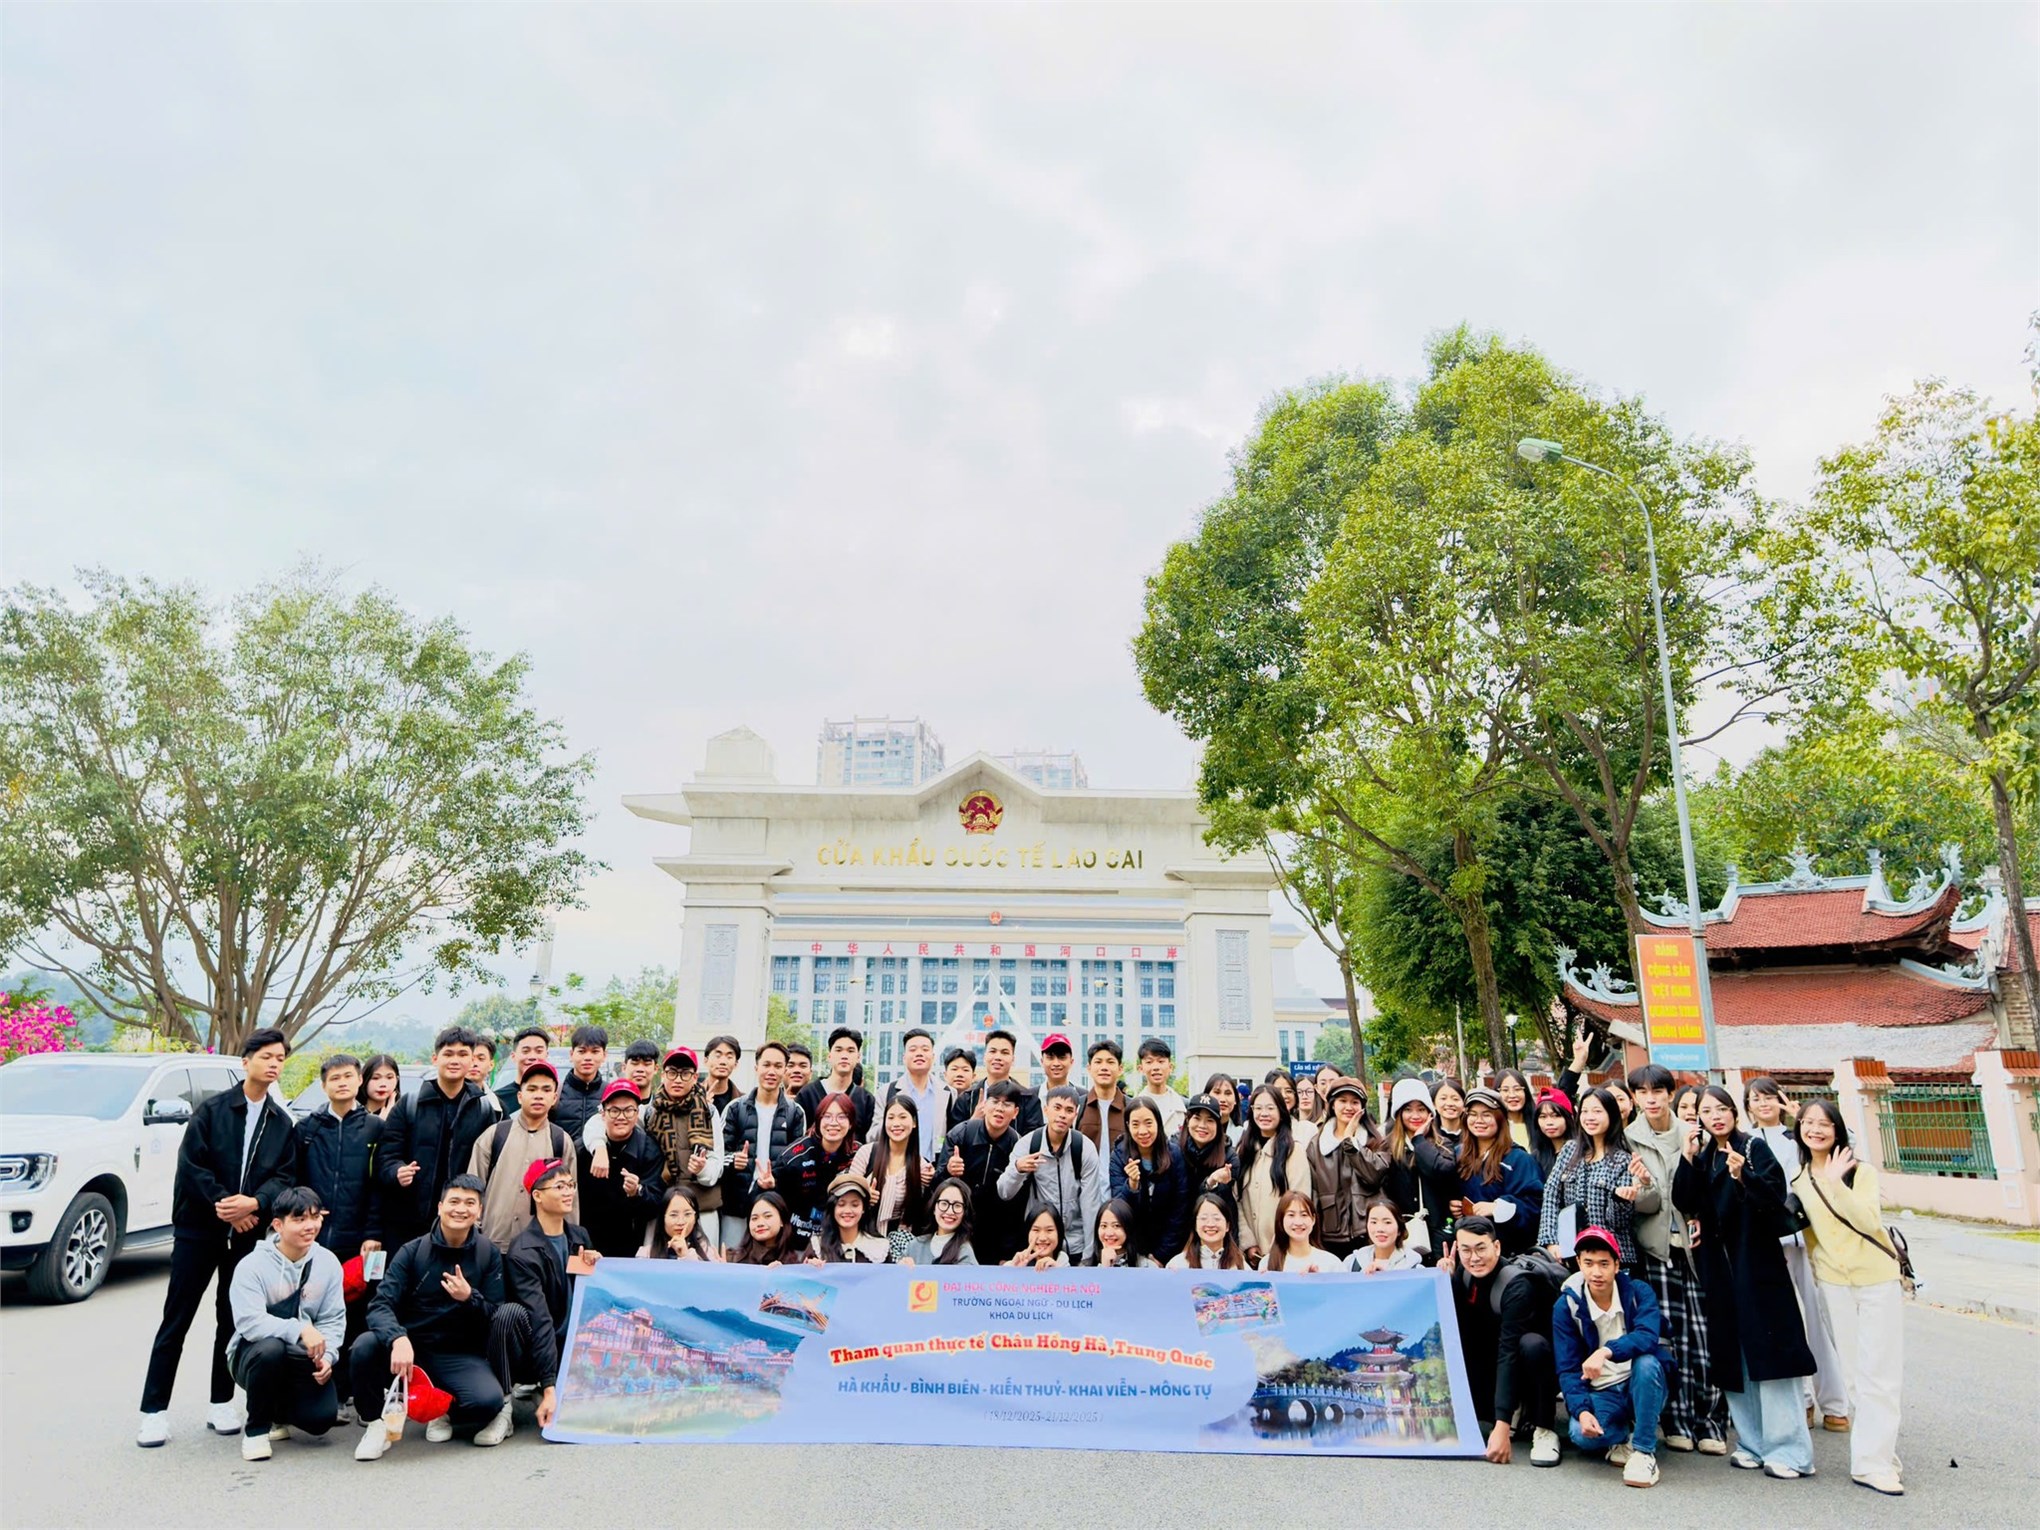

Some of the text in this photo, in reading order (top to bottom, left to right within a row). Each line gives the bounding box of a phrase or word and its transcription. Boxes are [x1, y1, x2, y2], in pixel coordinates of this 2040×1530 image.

[1105, 848, 1142, 869] CAI
[811, 941, 1177, 959] 中华人民共和国河口口岸
[953, 1297, 992, 1307] TRƯỜNG
[995, 1298, 1025, 1308] NGOẠI
[1056, 1300, 1069, 1308] DU
[990, 1311, 1015, 1320] KHOA
[1017, 1312, 1030, 1320] DU
[830, 1346, 880, 1364] Tham
[882, 1342, 925, 1358] quan
[929, 1338, 966, 1353] thực
[969, 1332, 987, 1349] tế
[991, 1334, 1033, 1348] Châu
[1170, 1349, 1213, 1368] Quốc
[838, 1377, 857, 1393] HÀ
[861, 1373, 900, 1393] KHẨU
[911, 1378, 945, 1394] BÌNH
[948, 1379, 980, 1395] BIÊN
[990, 1377, 1022, 1396] KIẾN
[1069, 1384, 1103, 1396] KHAI
[1106, 1378, 1137, 1396] VIỄN
[1149, 1380, 1191, 1396] MÔNG
[1193, 1383, 1213, 1400] TỰ
